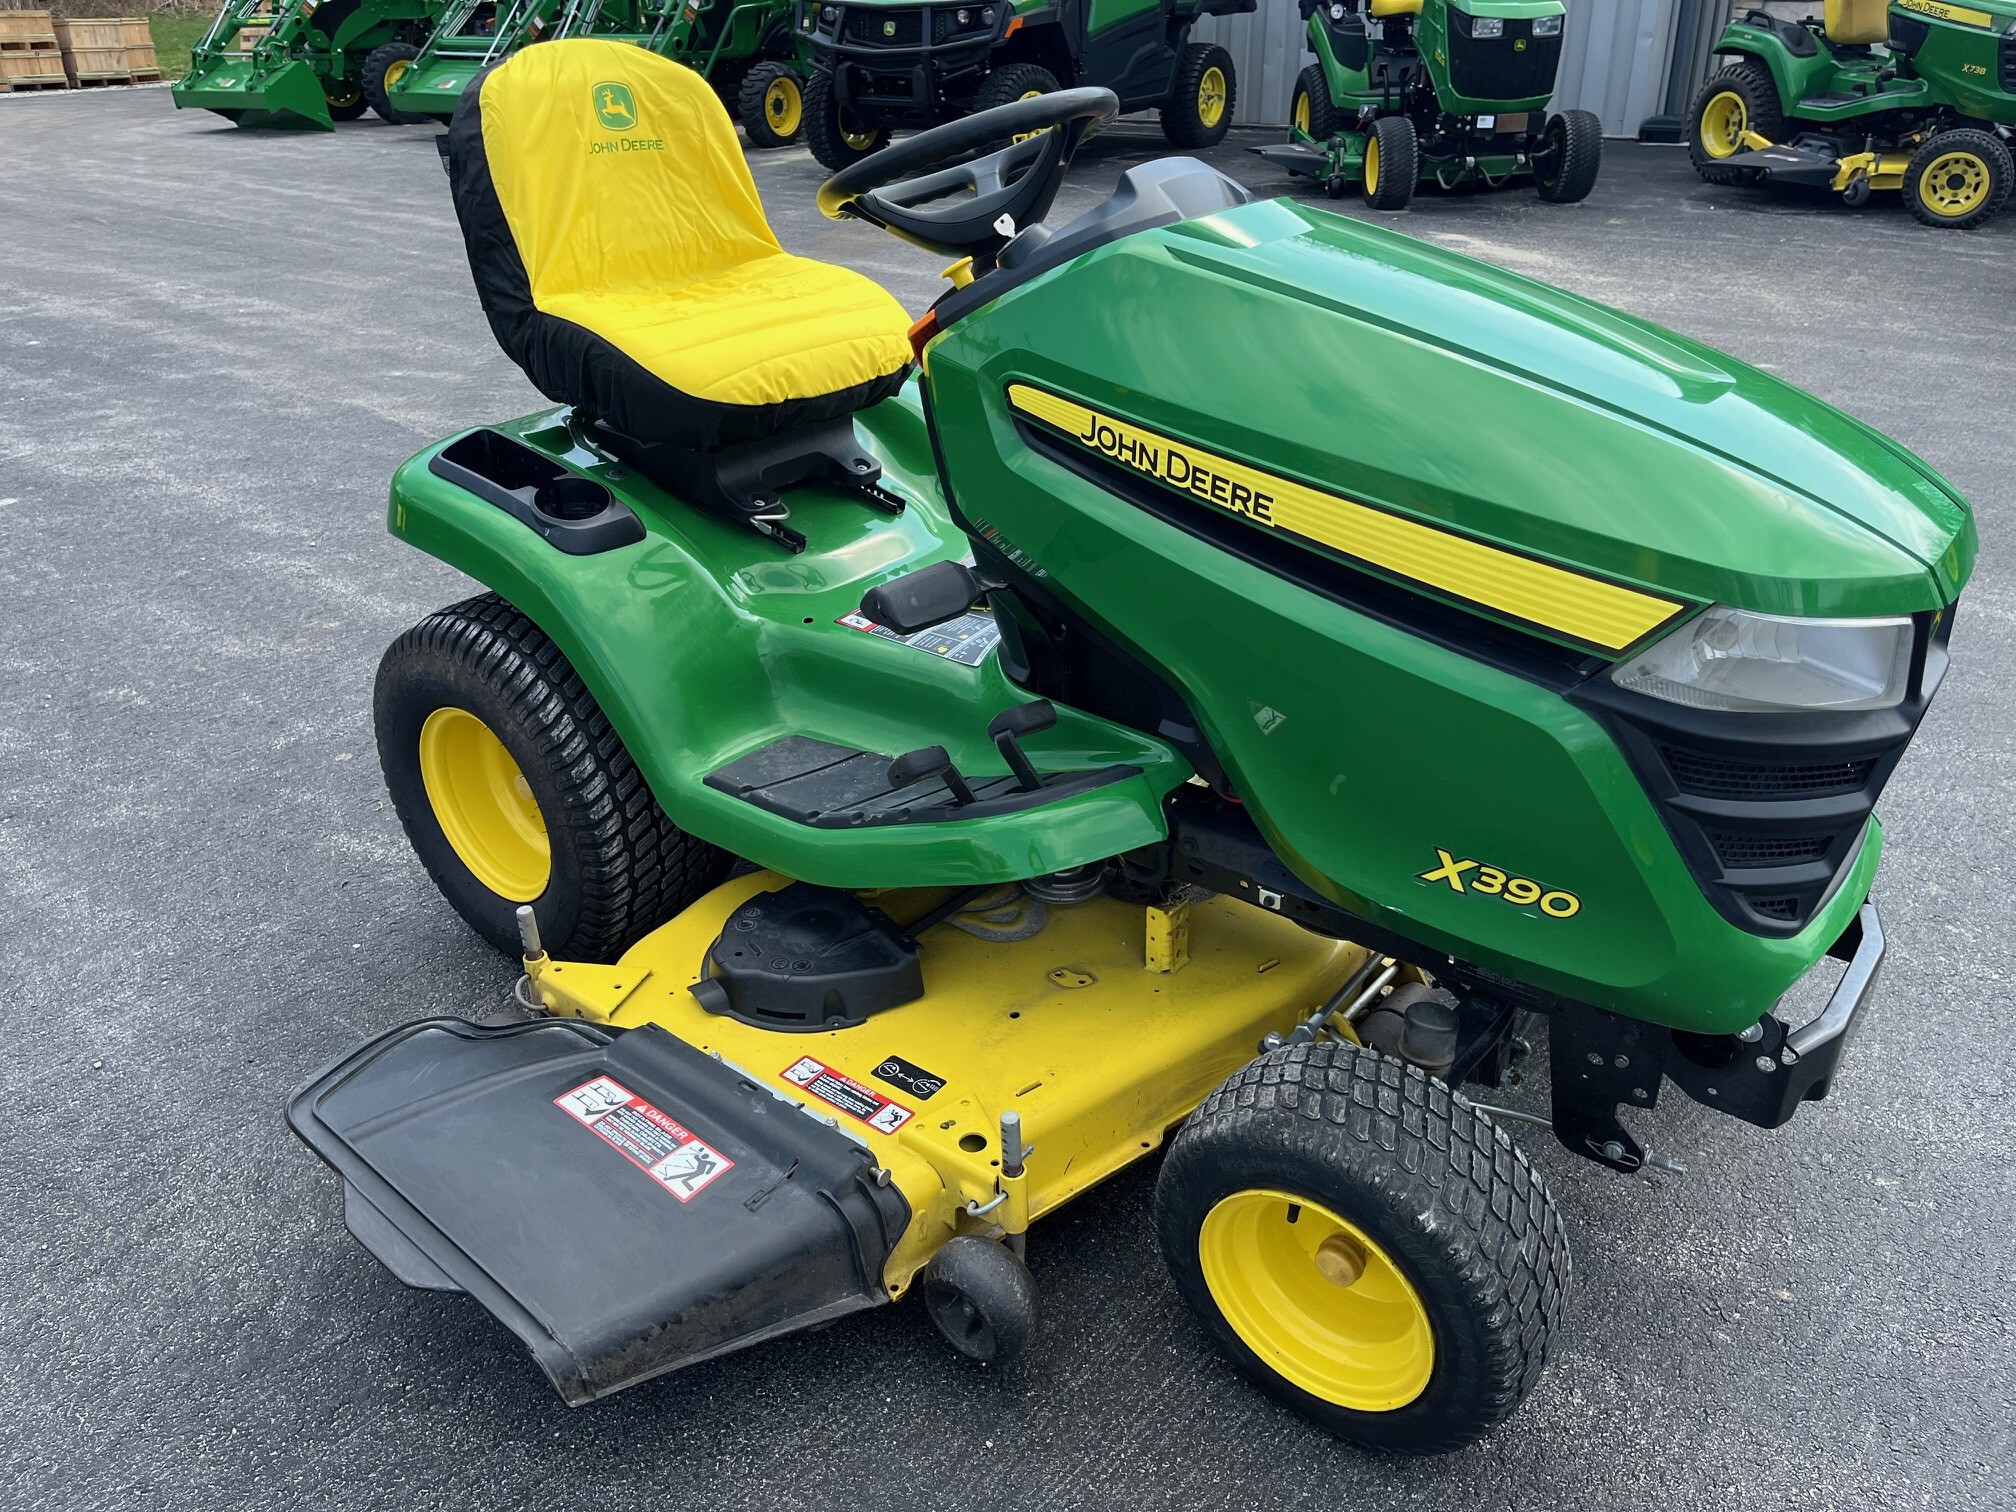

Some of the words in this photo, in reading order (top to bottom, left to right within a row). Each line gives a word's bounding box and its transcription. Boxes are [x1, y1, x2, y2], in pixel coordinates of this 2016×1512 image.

[1903, 0, 1922, 11] JOHN
[1923, 2, 1951, 18] DEERE
[1961, 63, 1987, 75] X738
[589, 141, 618, 155] JOHN
[621, 139, 664, 152] DEERE
[1080, 415, 1159, 475] JOHN
[1166, 448, 1275, 523] DEERE
[1416, 846, 1582, 918] X390
[845, 1078, 877, 1097] DANGER
[644, 1109, 688, 1139] DANGER
